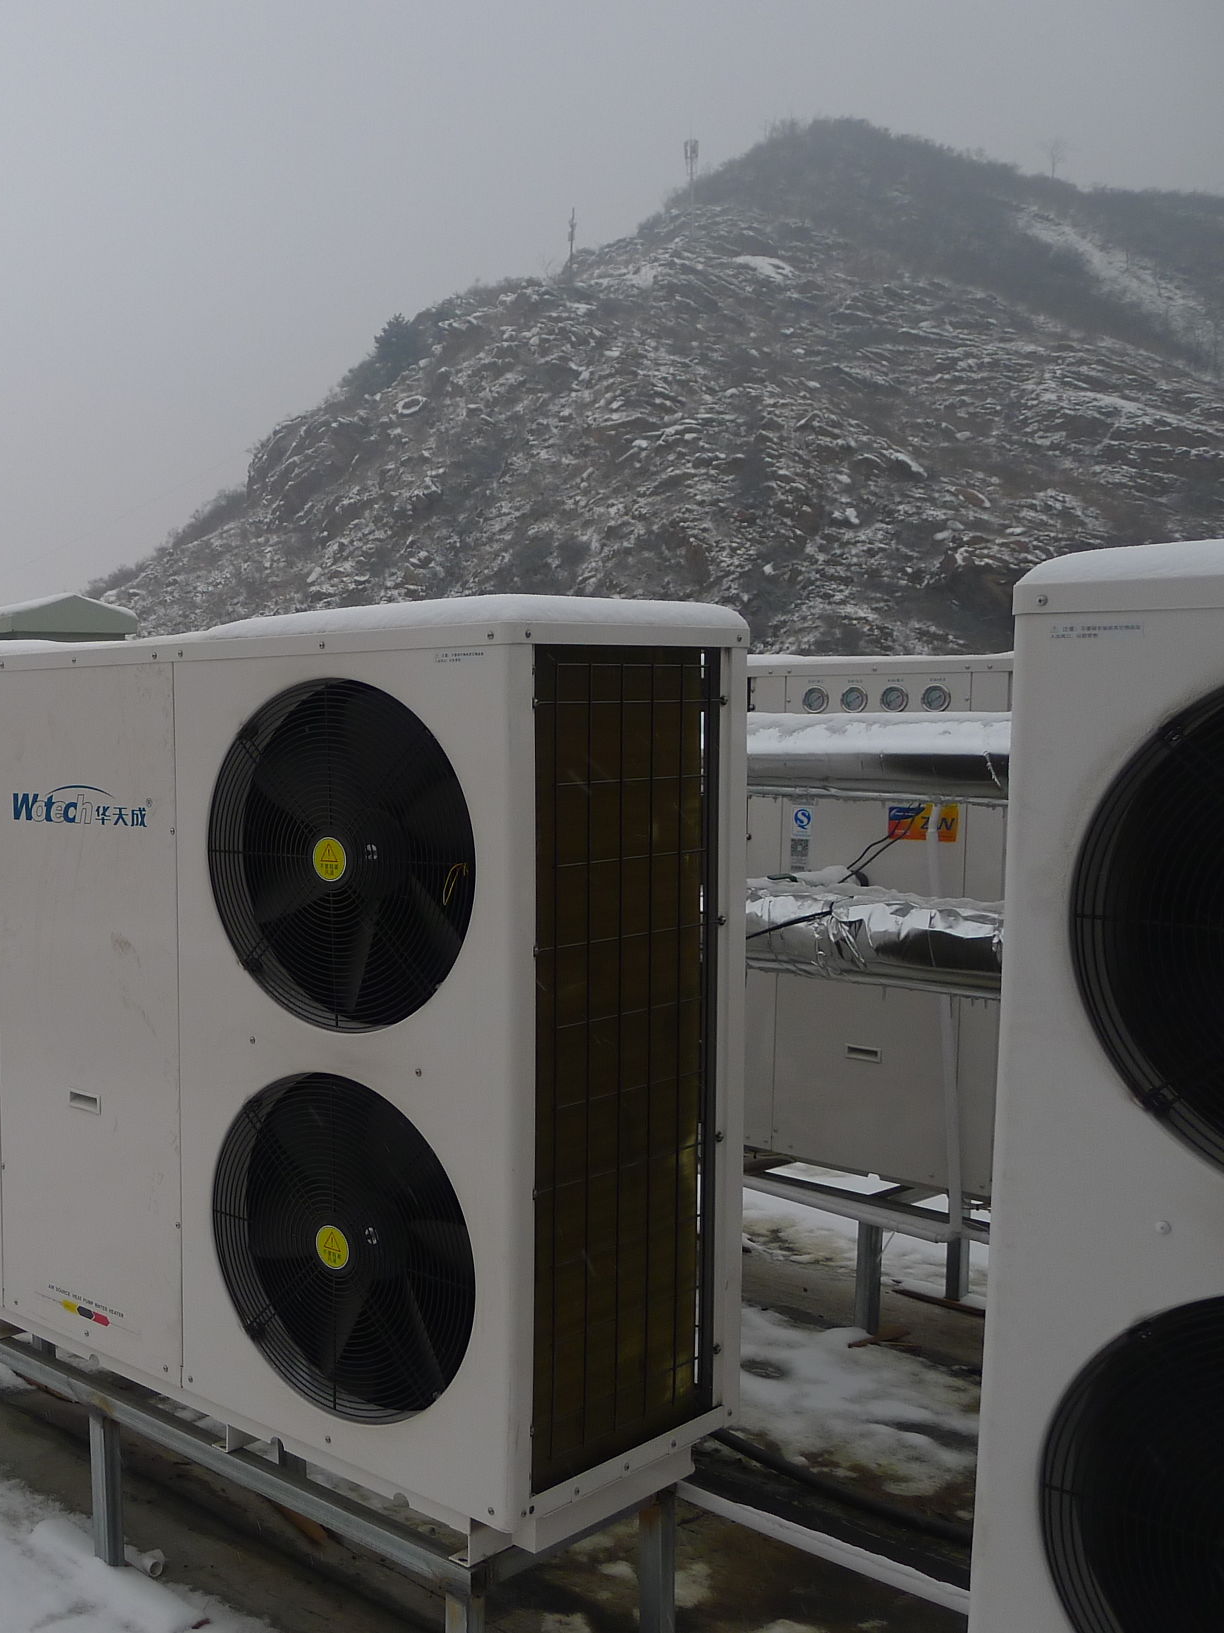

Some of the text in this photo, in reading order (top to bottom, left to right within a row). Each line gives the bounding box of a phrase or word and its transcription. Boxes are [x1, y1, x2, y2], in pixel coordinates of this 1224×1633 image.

[12, 792, 148, 827] Wotech 华天成
